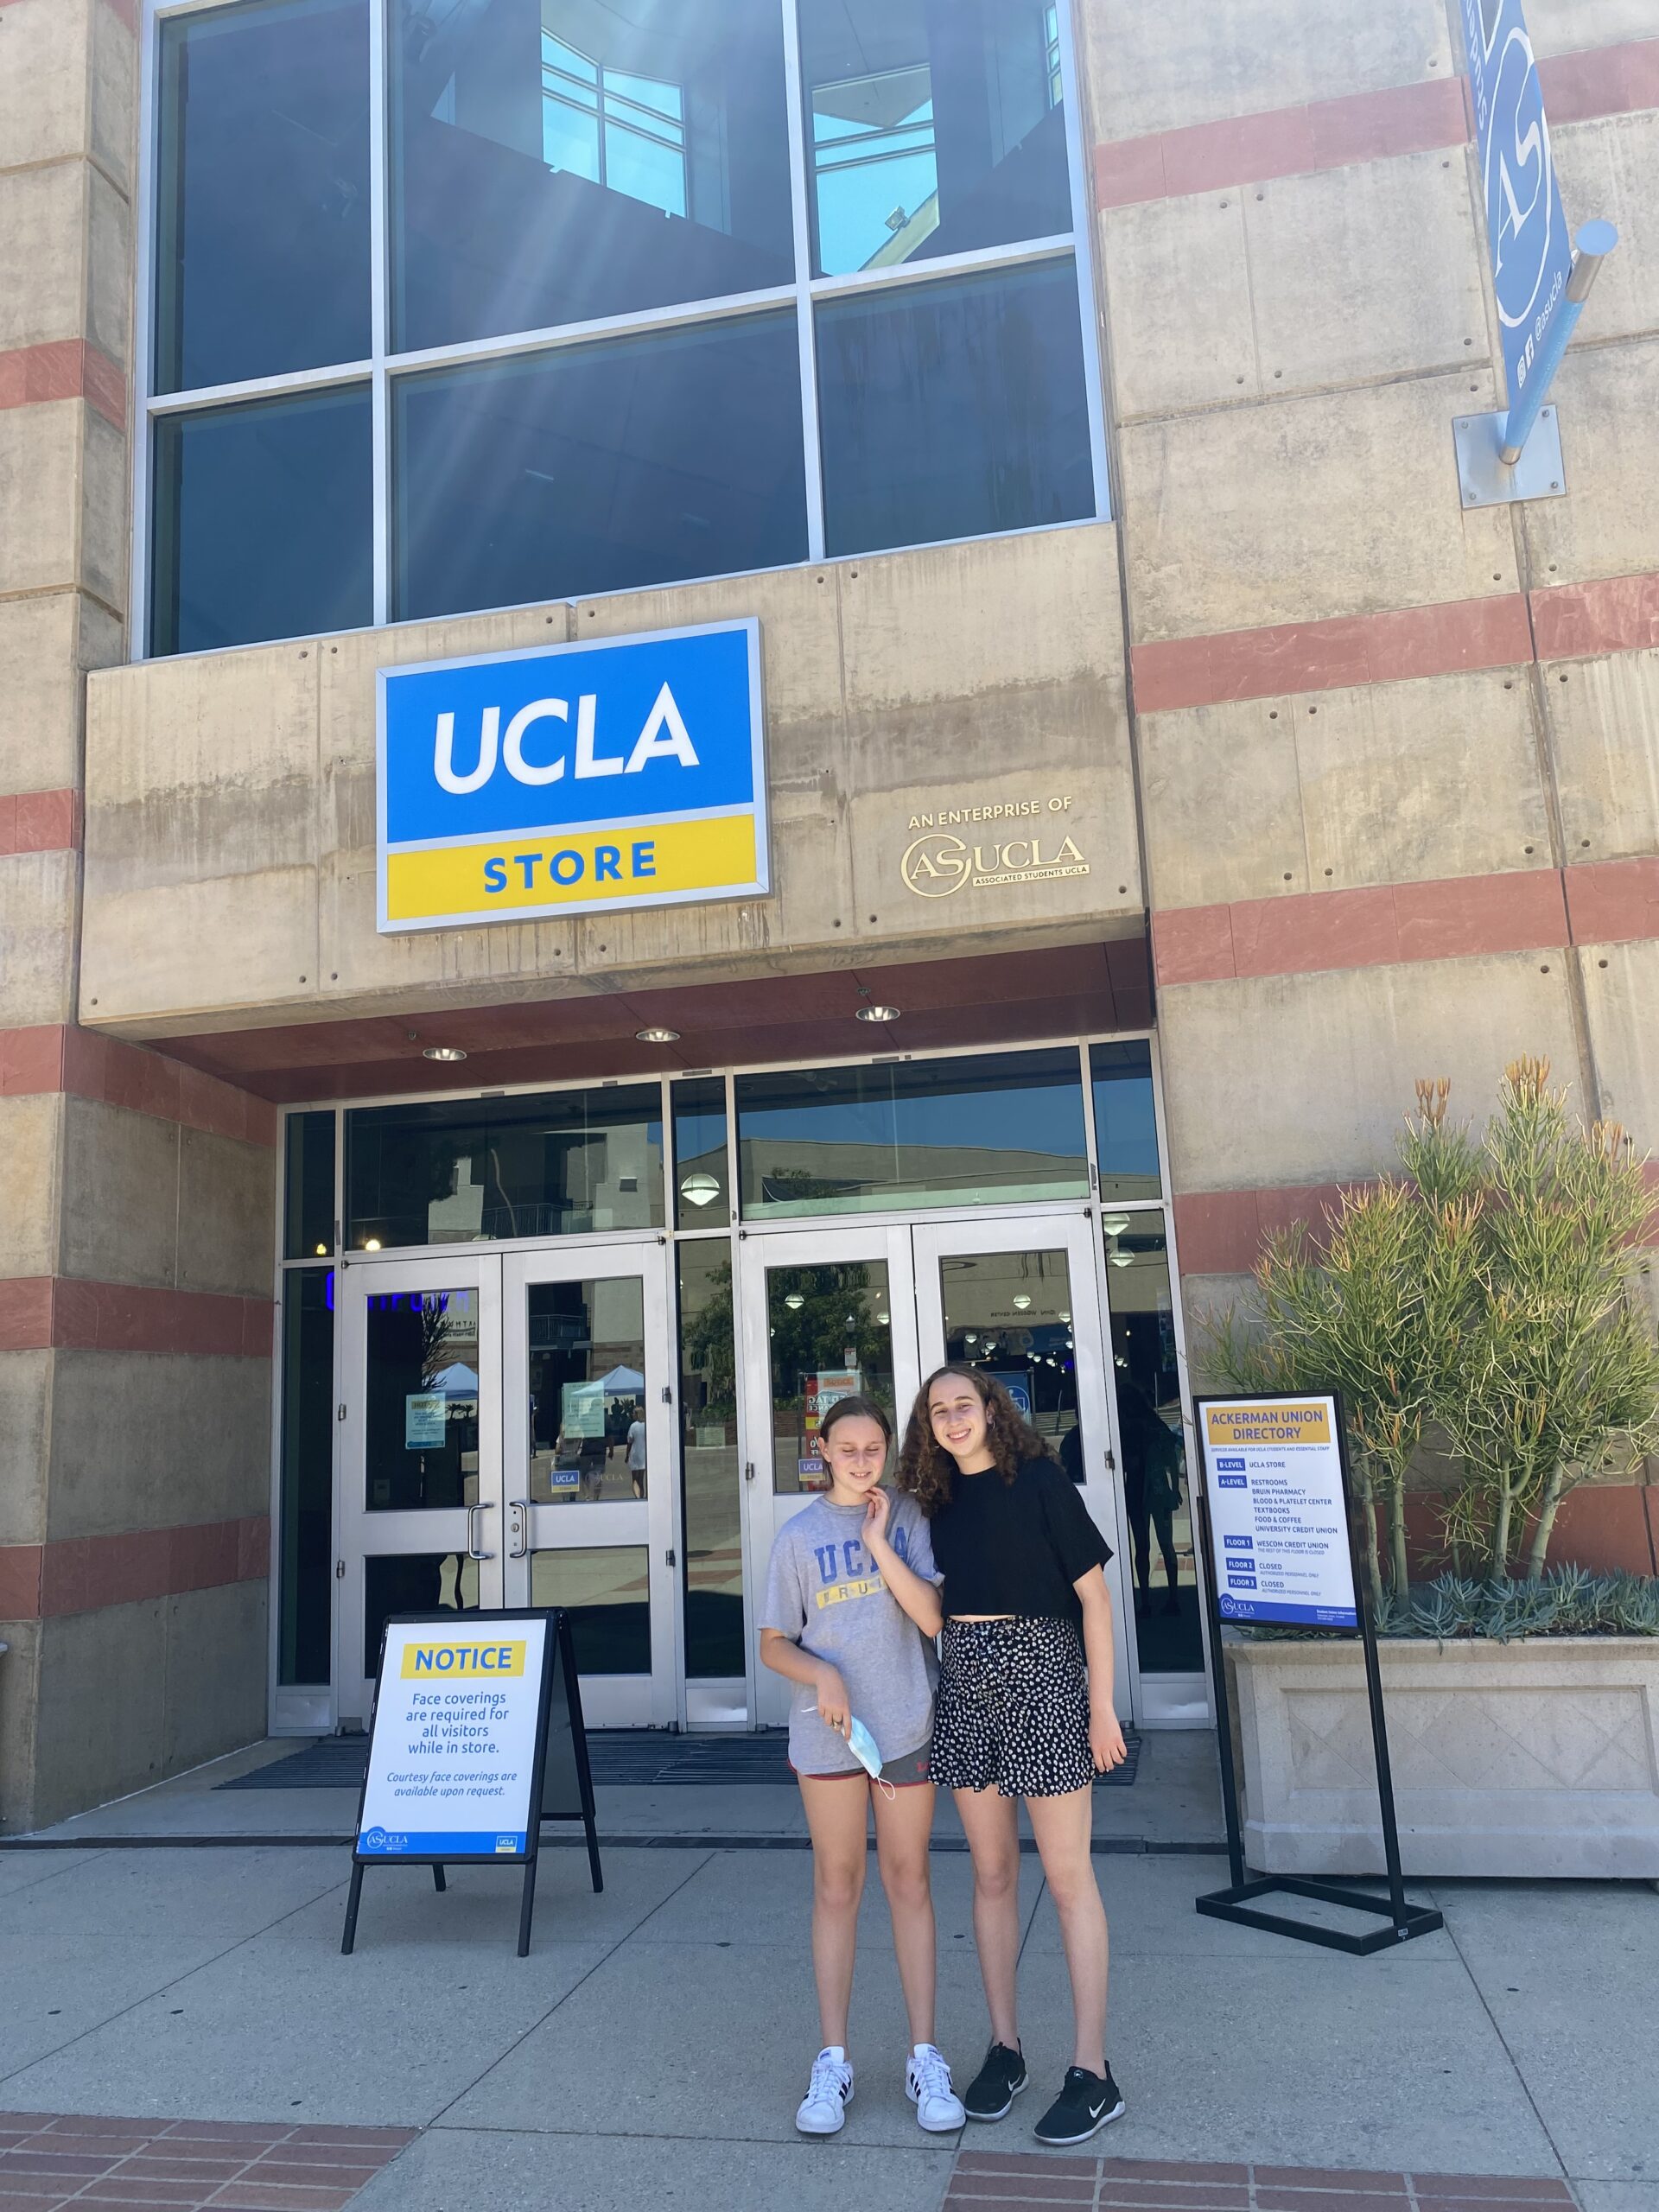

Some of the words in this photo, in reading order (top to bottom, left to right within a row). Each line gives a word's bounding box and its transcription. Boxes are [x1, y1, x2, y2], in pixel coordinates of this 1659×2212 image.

[1535, 270, 1563, 341] @asucla
[433, 680, 700, 794] UCLA
[908, 813, 933, 830] AN
[938, 800, 1040, 825] ENTERPRISE
[1048, 796, 1072, 812] OF
[483, 841, 657, 893] STORE
[976, 874, 1022, 885] ASSOCIATED
[1025, 869, 1063, 880] STUDENTS
[1065, 866, 1088, 875] UCLA
[1211, 1412, 1278, 1425] ACKERMAN
[1281, 1410, 1323, 1423] UNION
[1233, 1427, 1301, 1440] DIRECTORY
[415, 1647, 512, 1670] NOTICE
[413, 1693, 441, 1705] Face
[444, 1691, 506, 1707] coverings
[406, 1712, 427, 1721] are
[430, 1707, 486, 1723] required
[489, 1707, 509, 1720] for
[422, 1725, 437, 1737] all
[442, 1725, 489, 1737] visitors
[409, 1741, 442, 1754] while
[447, 1741, 458, 1753] in
[461, 1741, 499, 1753] store.
[387, 1772, 429, 1783] Courtesy
[429, 1771, 450, 1783] face
[454, 1771, 499, 1783] coverings
[501, 1772, 517, 1781] are
[394, 1786, 437, 1796] available
[440, 1788, 464, 1798] upon
[467, 1787, 505, 1797] request.
[367, 1831, 408, 1849] ASUCLA
